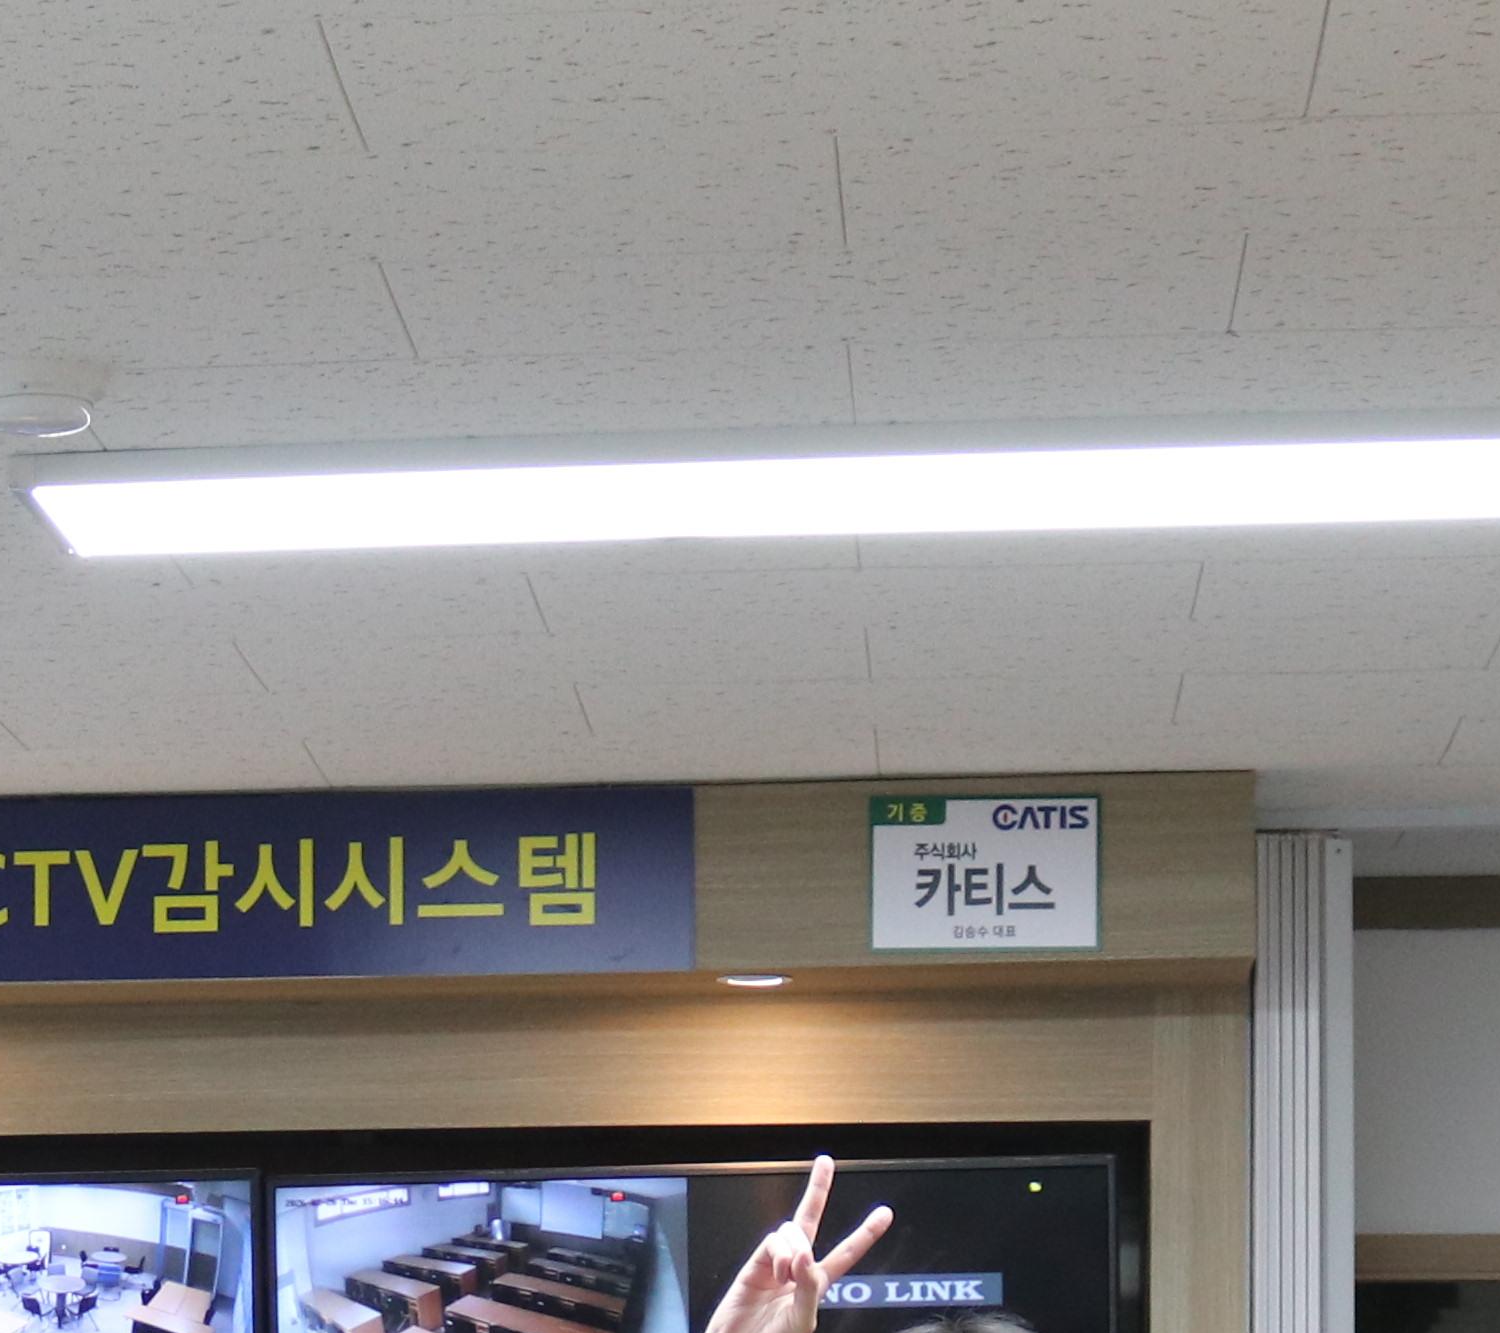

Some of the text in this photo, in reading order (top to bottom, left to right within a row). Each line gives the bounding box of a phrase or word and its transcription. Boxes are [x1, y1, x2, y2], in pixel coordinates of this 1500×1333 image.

[992, 804, 1090, 831] CATIS
[913, 842, 977, 861] 주식회사
[914, 862, 1056, 916] 카티스
[820, 1280, 985, 1304] NO LINK
